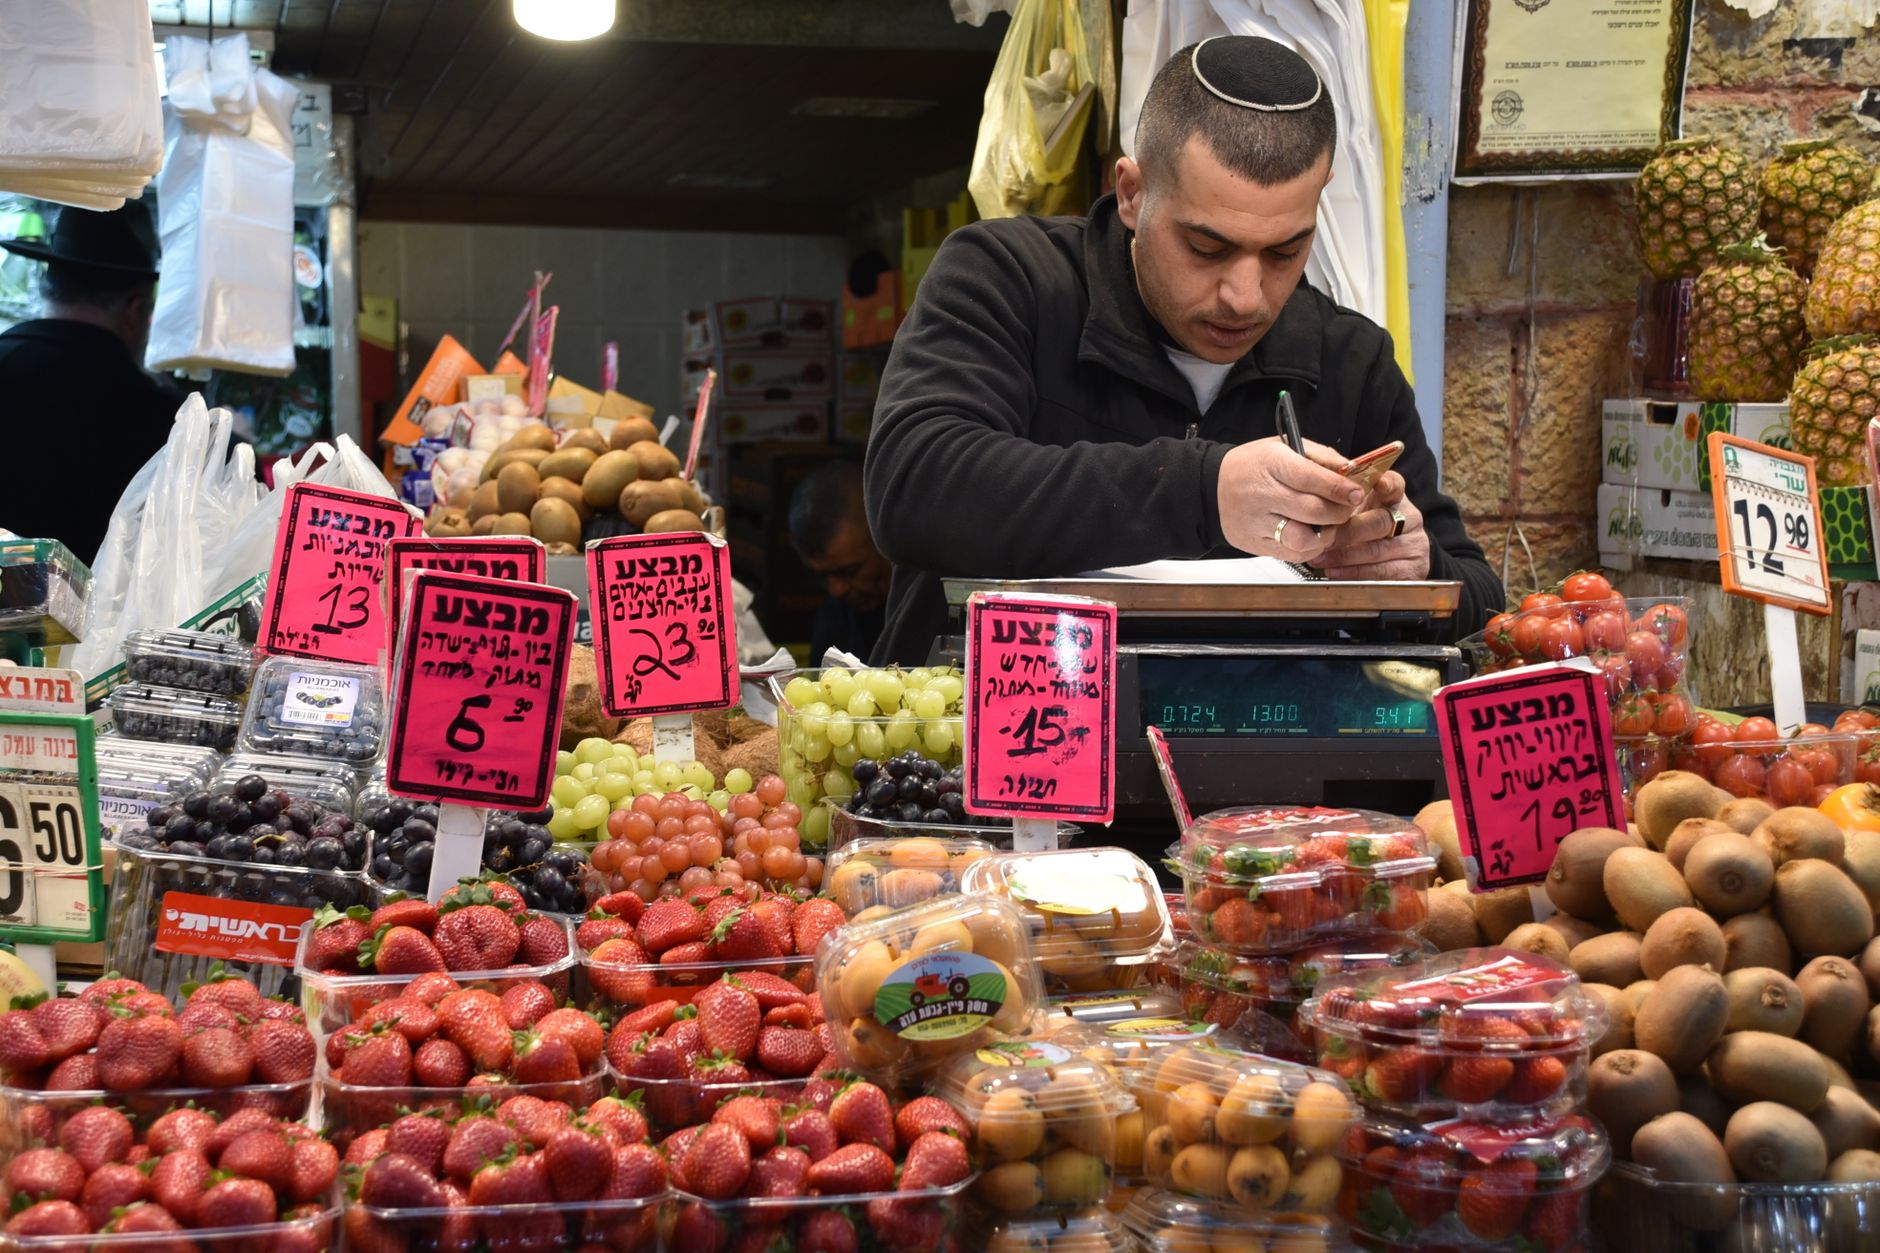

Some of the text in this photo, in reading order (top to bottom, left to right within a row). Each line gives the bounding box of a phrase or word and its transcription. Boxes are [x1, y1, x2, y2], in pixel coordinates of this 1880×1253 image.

[1775, 472, 1805, 492] שרי
[308, 507, 396, 540] מבצע
[1734, 499, 1785, 577] 12
[614, 553, 703, 580] מבצע
[311, 583, 370, 635] 13
[431, 594, 549, 636] מבצע
[628, 622, 696, 681] 23
[991, 619, 1093, 650] מבצע
[296, 675, 352, 689] אוכמניות
[484, 664, 542, 690] מתוק
[445, 694, 492, 752] 6
[1163, 704, 1412, 725] 0.724 13.00 9.41
[1469, 691, 1575, 733] מבצע
[43, 736, 77, 759] בננה
[1490, 754, 1599, 801] בראשית
[30, 801, 84, 867] 50
[1520, 797, 1577, 852] 19
[966, 999, 989, 1014] משק
